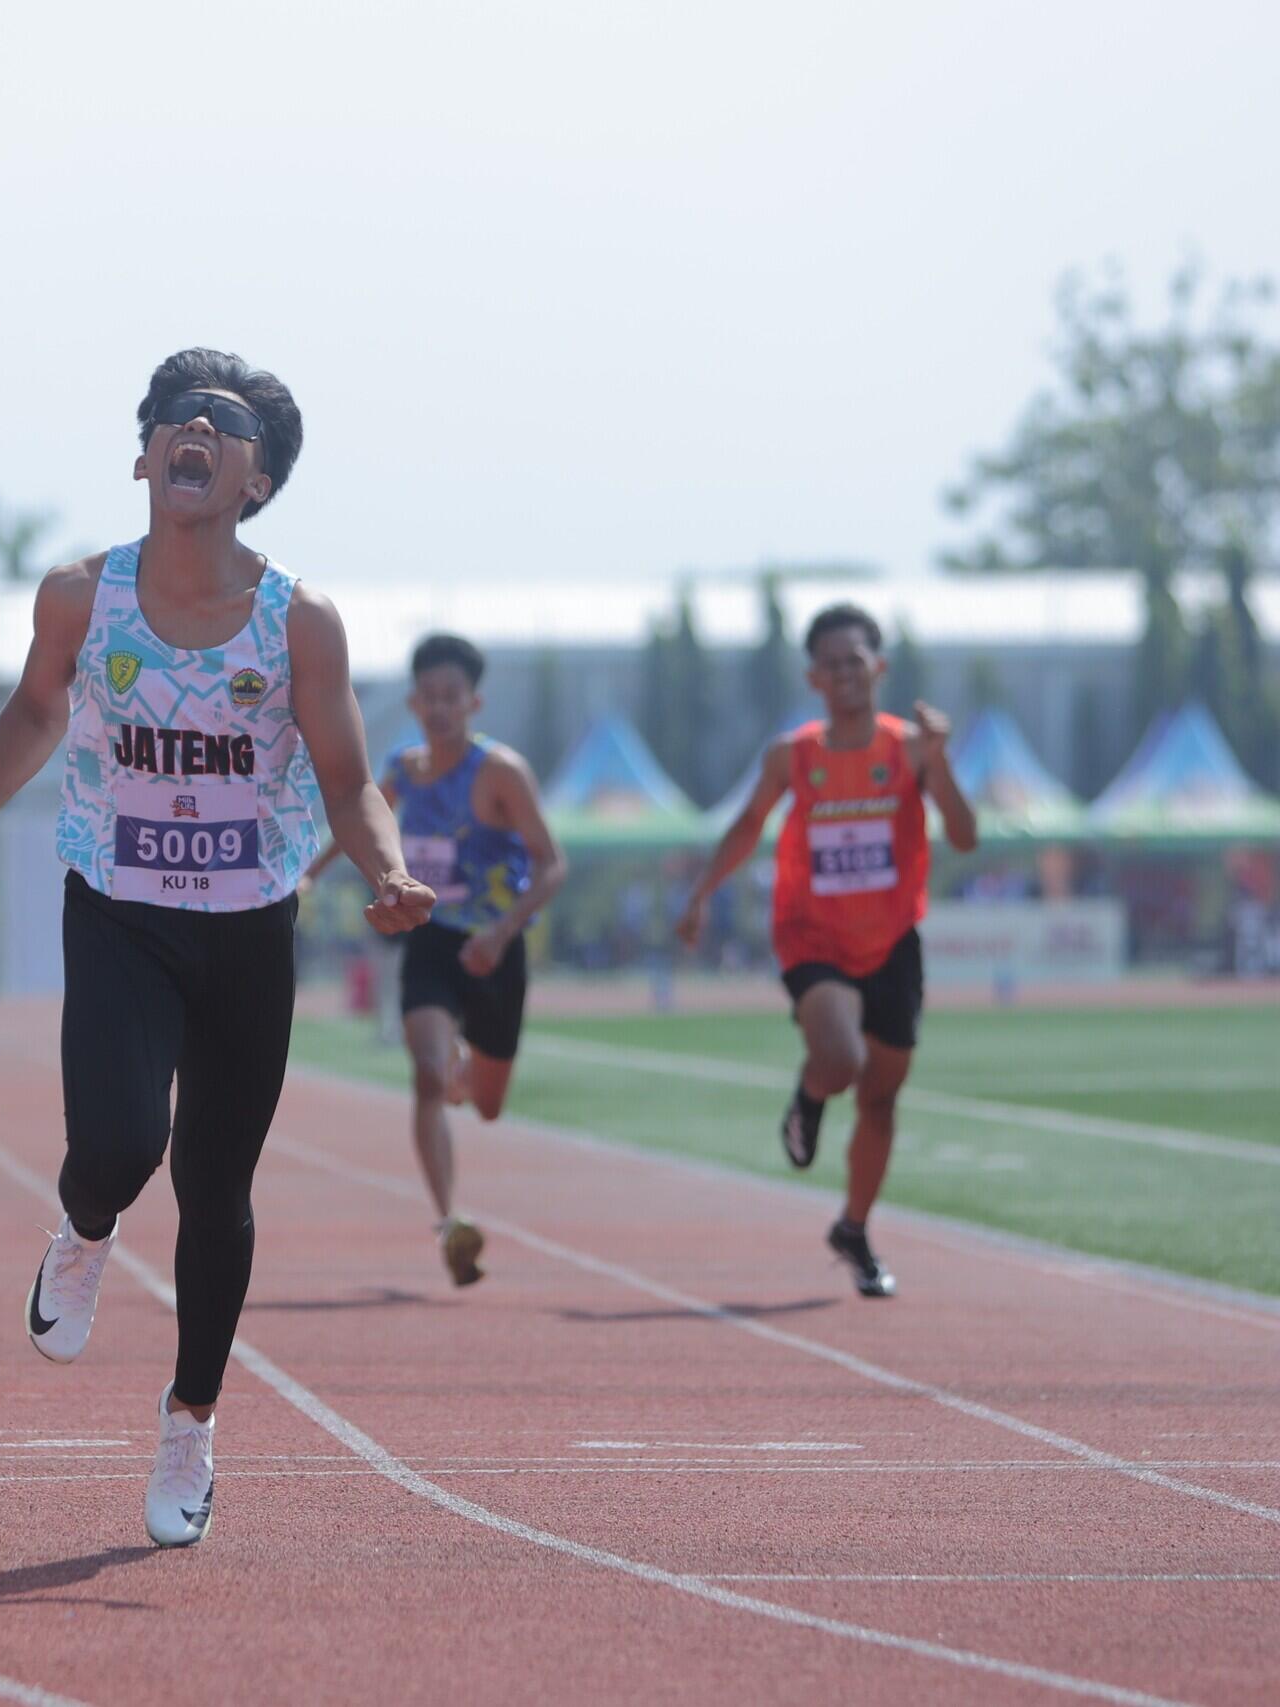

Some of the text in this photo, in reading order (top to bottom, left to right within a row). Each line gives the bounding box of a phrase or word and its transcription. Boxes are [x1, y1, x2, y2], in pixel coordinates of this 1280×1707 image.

[114, 724, 255, 776] JATENG
[136, 826, 242, 864] 5009
[162, 875, 210, 890] KU 18
